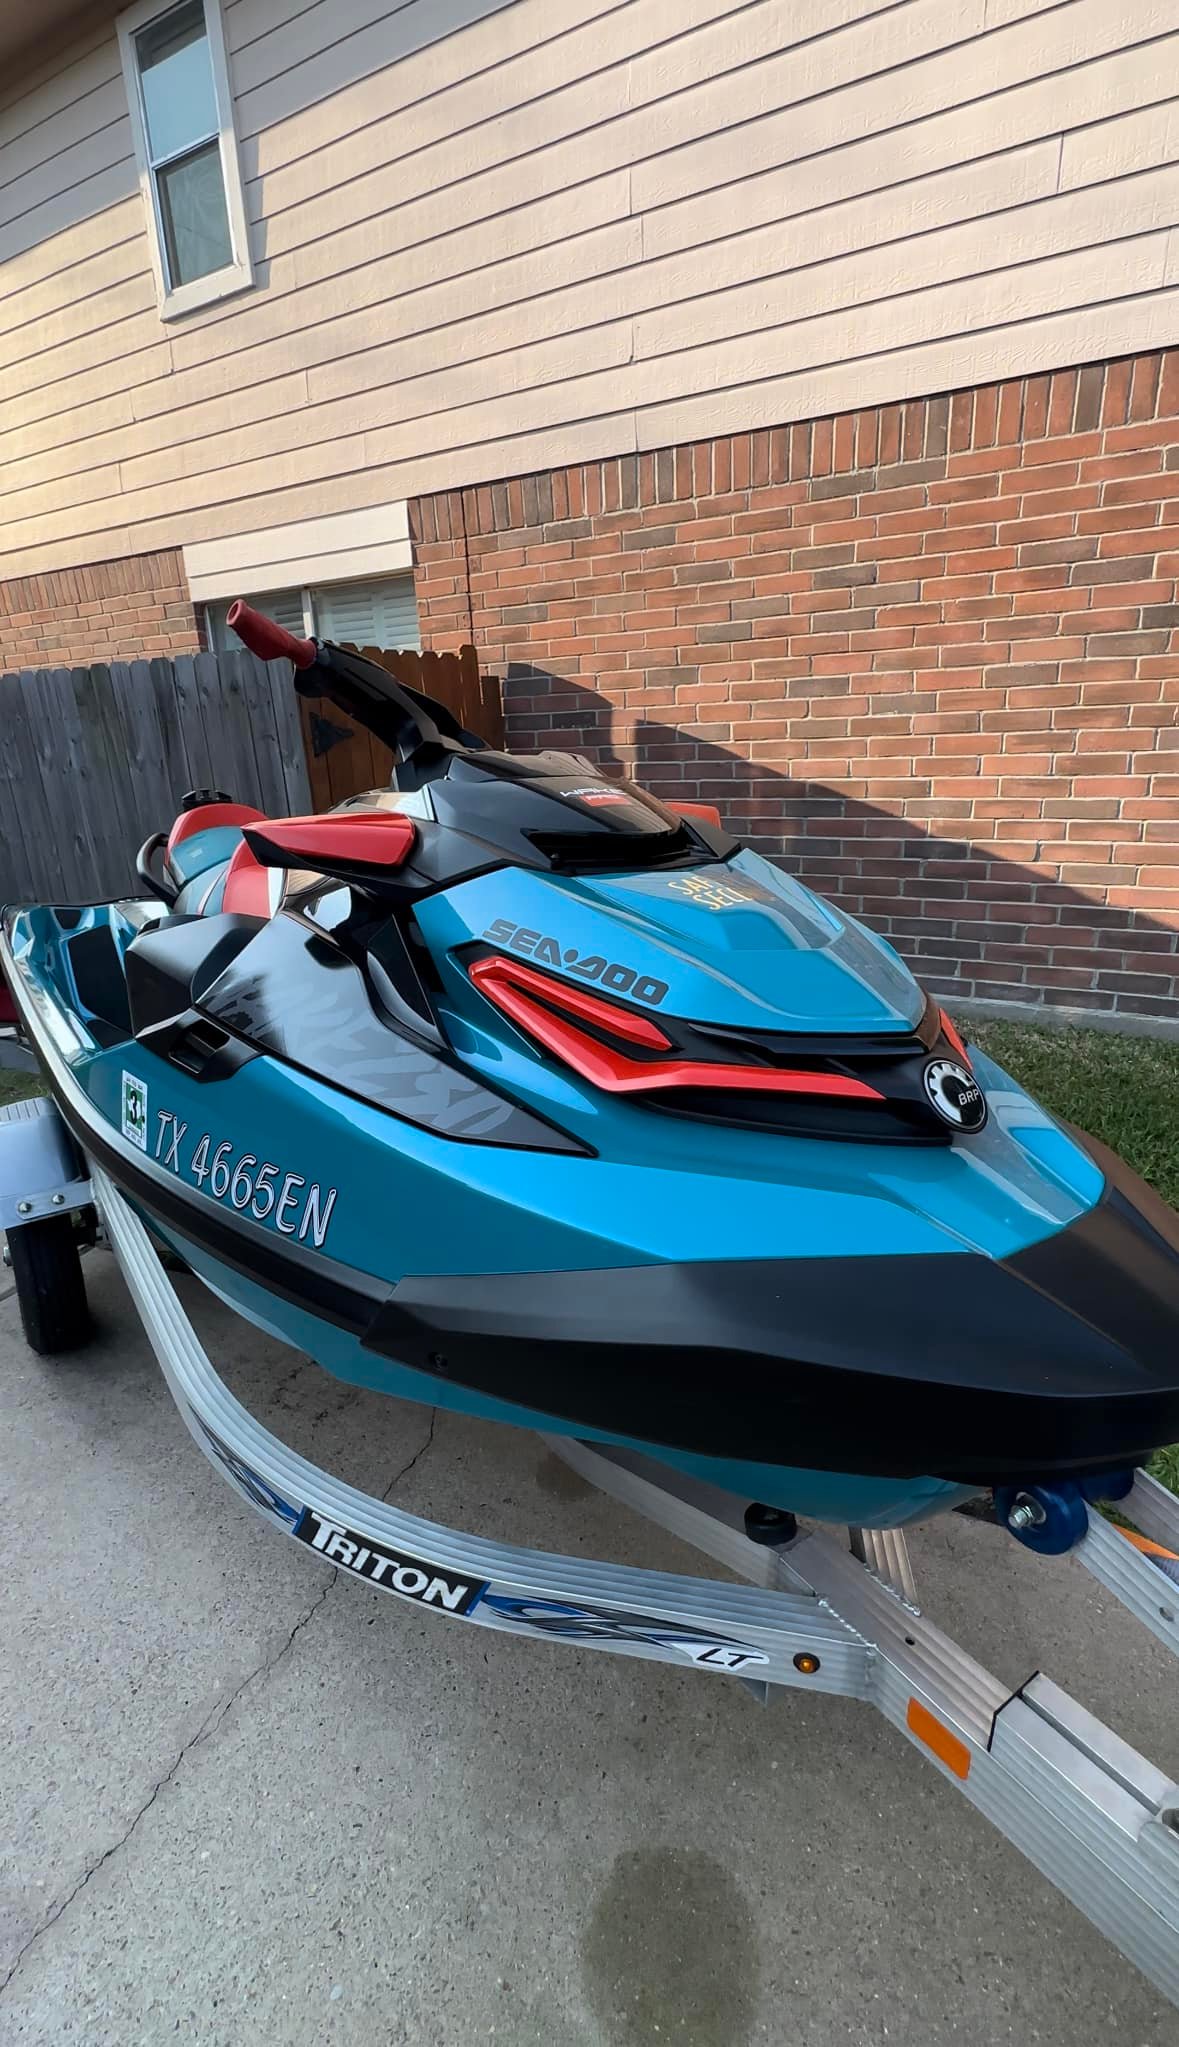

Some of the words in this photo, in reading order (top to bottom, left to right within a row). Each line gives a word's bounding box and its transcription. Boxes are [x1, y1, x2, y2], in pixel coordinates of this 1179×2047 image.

[957, 1088, 979, 1106] BRP
[155, 1109, 188, 1174] TX
[190, 1133, 338, 1249] 4665EN
[310, 1511, 469, 1610] TRITON
[696, 1647, 764, 1668] LT
